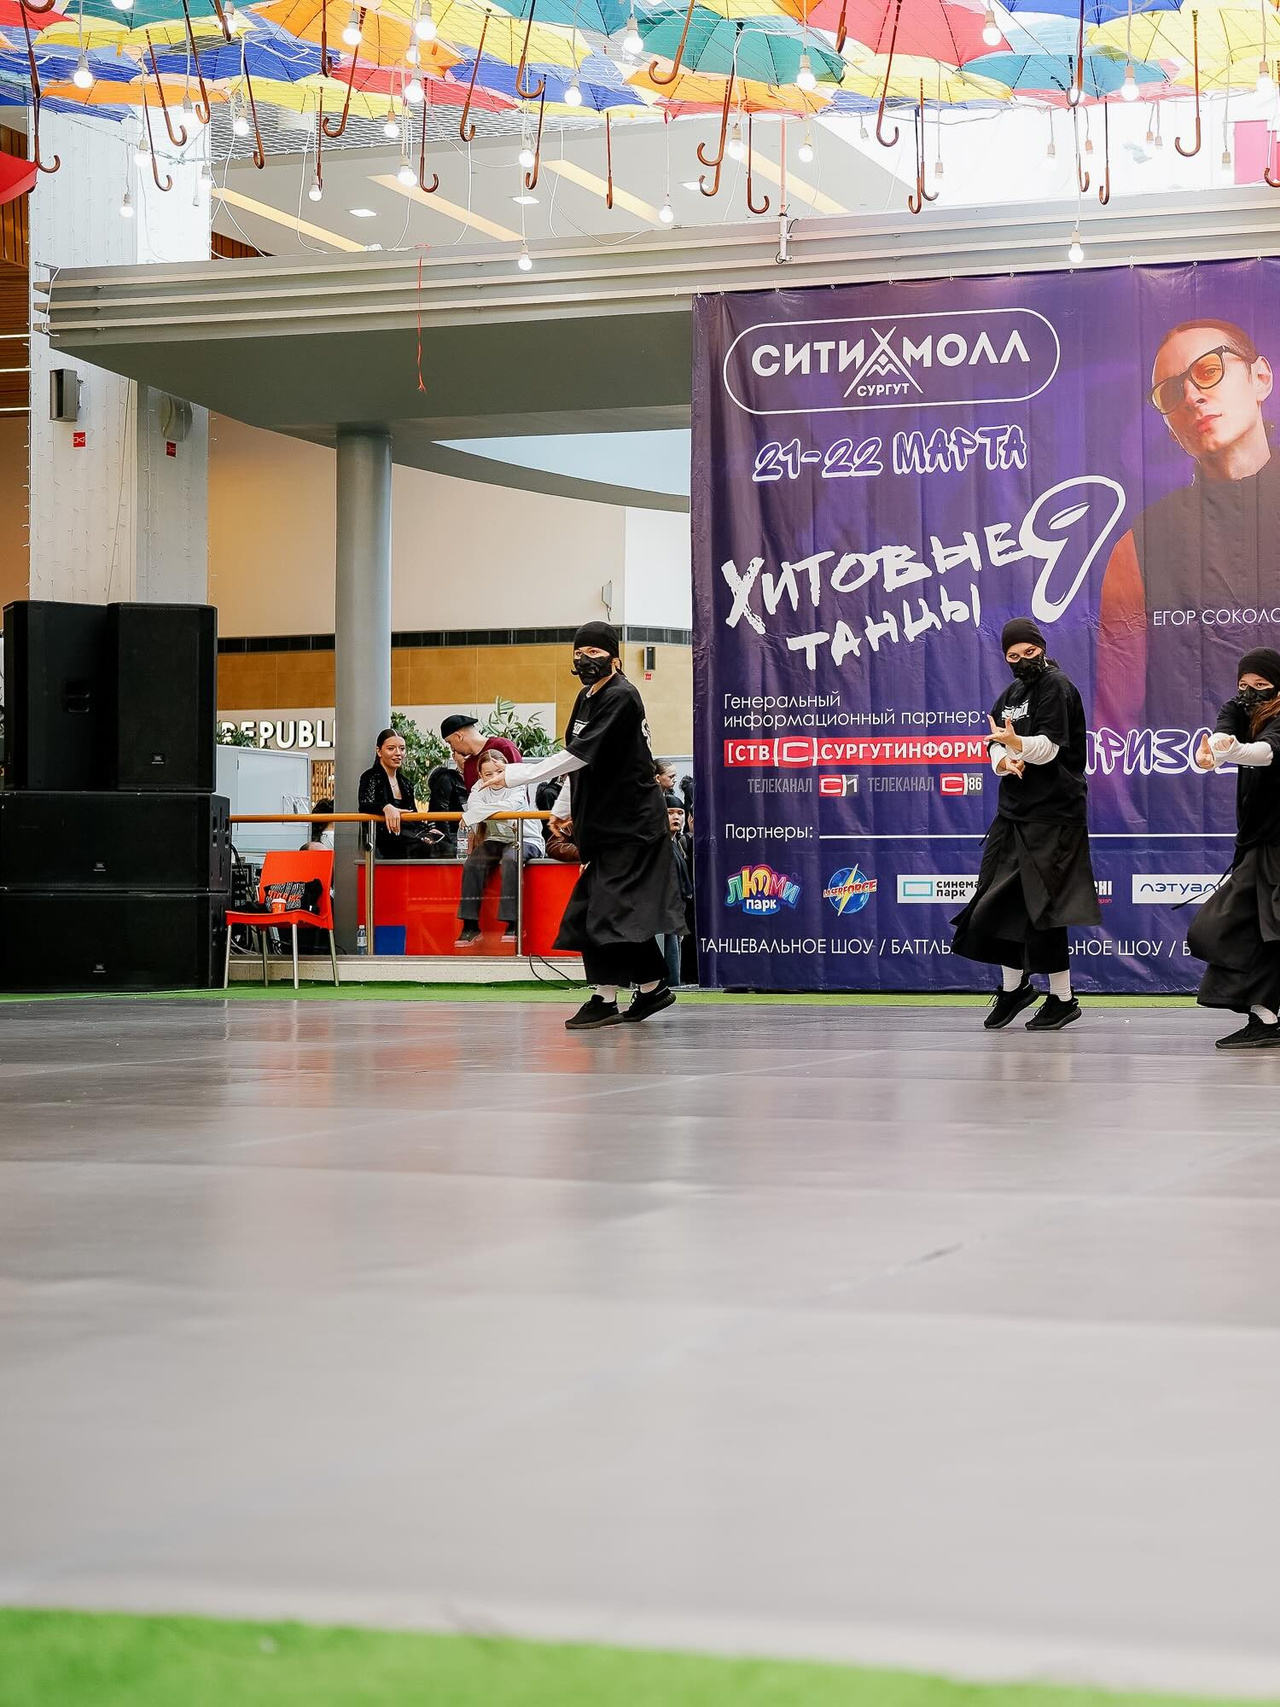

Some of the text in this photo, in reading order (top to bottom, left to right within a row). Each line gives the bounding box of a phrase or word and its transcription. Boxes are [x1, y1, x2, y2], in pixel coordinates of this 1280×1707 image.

[751, 329, 1031, 377] СИТИ МОЛЛ
[857, 382, 910, 397] СУРГУТ
[752, 424, 1028, 482] 21-22 МАРТА
[1153, 609, 1197, 626] ЕГОР
[786, 584, 982, 671] ТАНЦЫ
[724, 691, 841, 712] Генеральный
[724, 708, 896, 731] информационный
[901, 709, 987, 728] партнер:
[217, 719, 336, 749] REPUBL
[748, 777, 813, 793] ТЕЛЕКАНАЛ
[868, 776, 935, 792] ТЕЛЕКАНАЛ
[725, 823, 813, 843] Партнеры:
[936, 890, 966, 900] парк
[746, 899, 777, 913] парк
[700, 938, 827, 955] ТАНЦЕВАЛЬНОЕ
[831, 939, 875, 955] ШОУ
[1118, 941, 1163, 956] ШОУ
